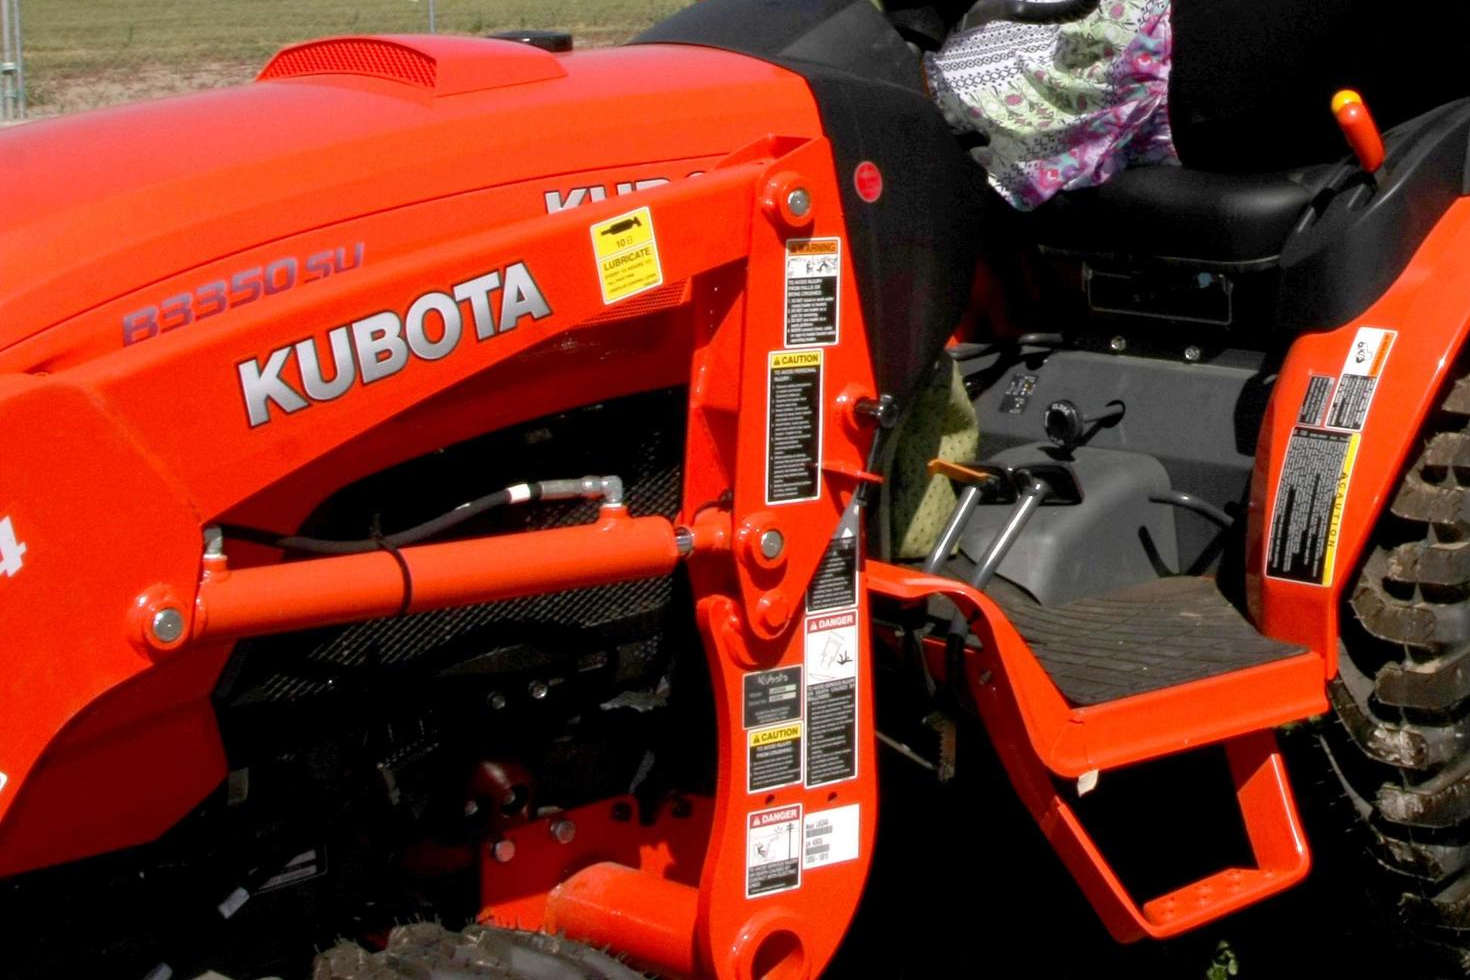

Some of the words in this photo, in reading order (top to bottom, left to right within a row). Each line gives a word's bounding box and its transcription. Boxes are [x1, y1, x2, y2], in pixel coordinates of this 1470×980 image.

[603, 247, 650, 271] LUBRICATE
[122, 256, 299, 348] B3350
[303, 242, 365, 284] SU
[236, 259, 552, 429] KUBOTA
[782, 354, 819, 365] CAUTION
[1327, 482, 1347, 548] CAUTION
[818, 615, 854, 629] DANGER
[761, 727, 799, 742] CAUTION
[762, 809, 798, 824] DANGER
